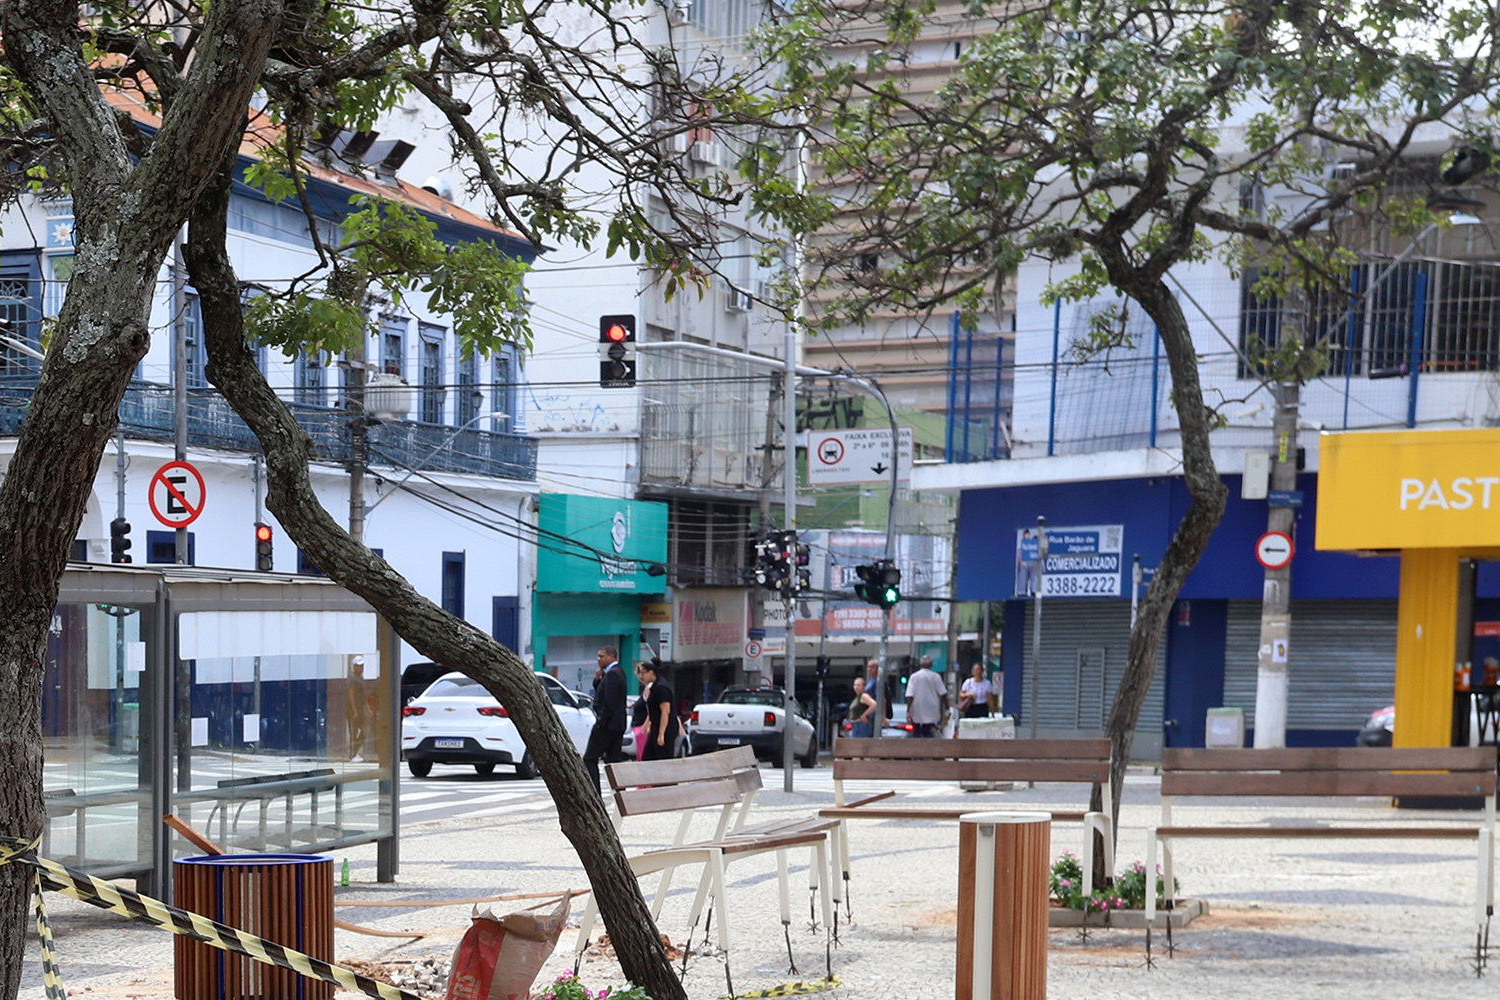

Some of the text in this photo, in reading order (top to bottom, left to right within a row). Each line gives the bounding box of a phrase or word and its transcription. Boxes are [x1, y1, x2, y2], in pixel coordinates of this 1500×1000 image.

[870, 430, 911, 440] EXCLUIVA
[1400, 477, 1500, 511] PAST
[1050, 535, 1063, 543] Rua
[1086, 535, 1095, 543] de
[1047, 555, 1117, 571] COMERCIALIZADO
[1047, 576, 1116, 593] 3388-2222
[694, 601, 717, 623] Kodak
